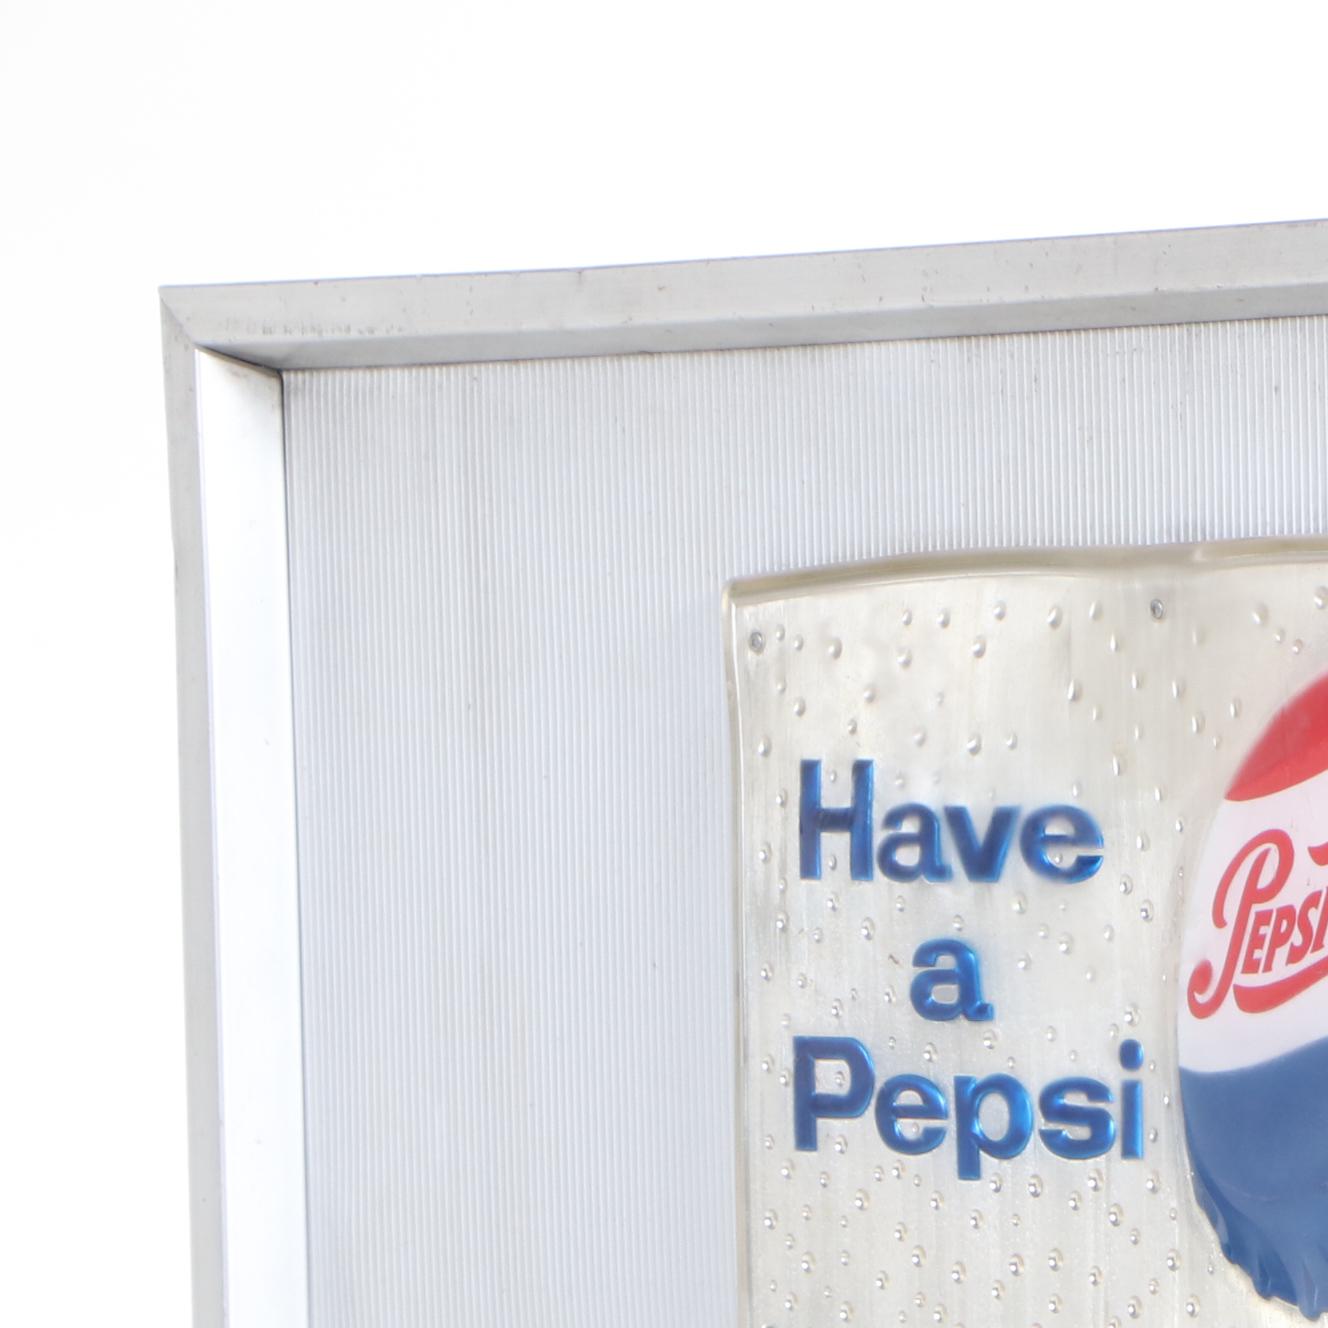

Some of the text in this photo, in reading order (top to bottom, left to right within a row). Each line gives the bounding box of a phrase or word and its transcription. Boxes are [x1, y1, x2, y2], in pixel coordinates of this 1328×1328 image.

[800, 758, 1105, 884] Have
[909, 936, 995, 1022] a
[793, 1035, 1145, 1181] Pepsi
